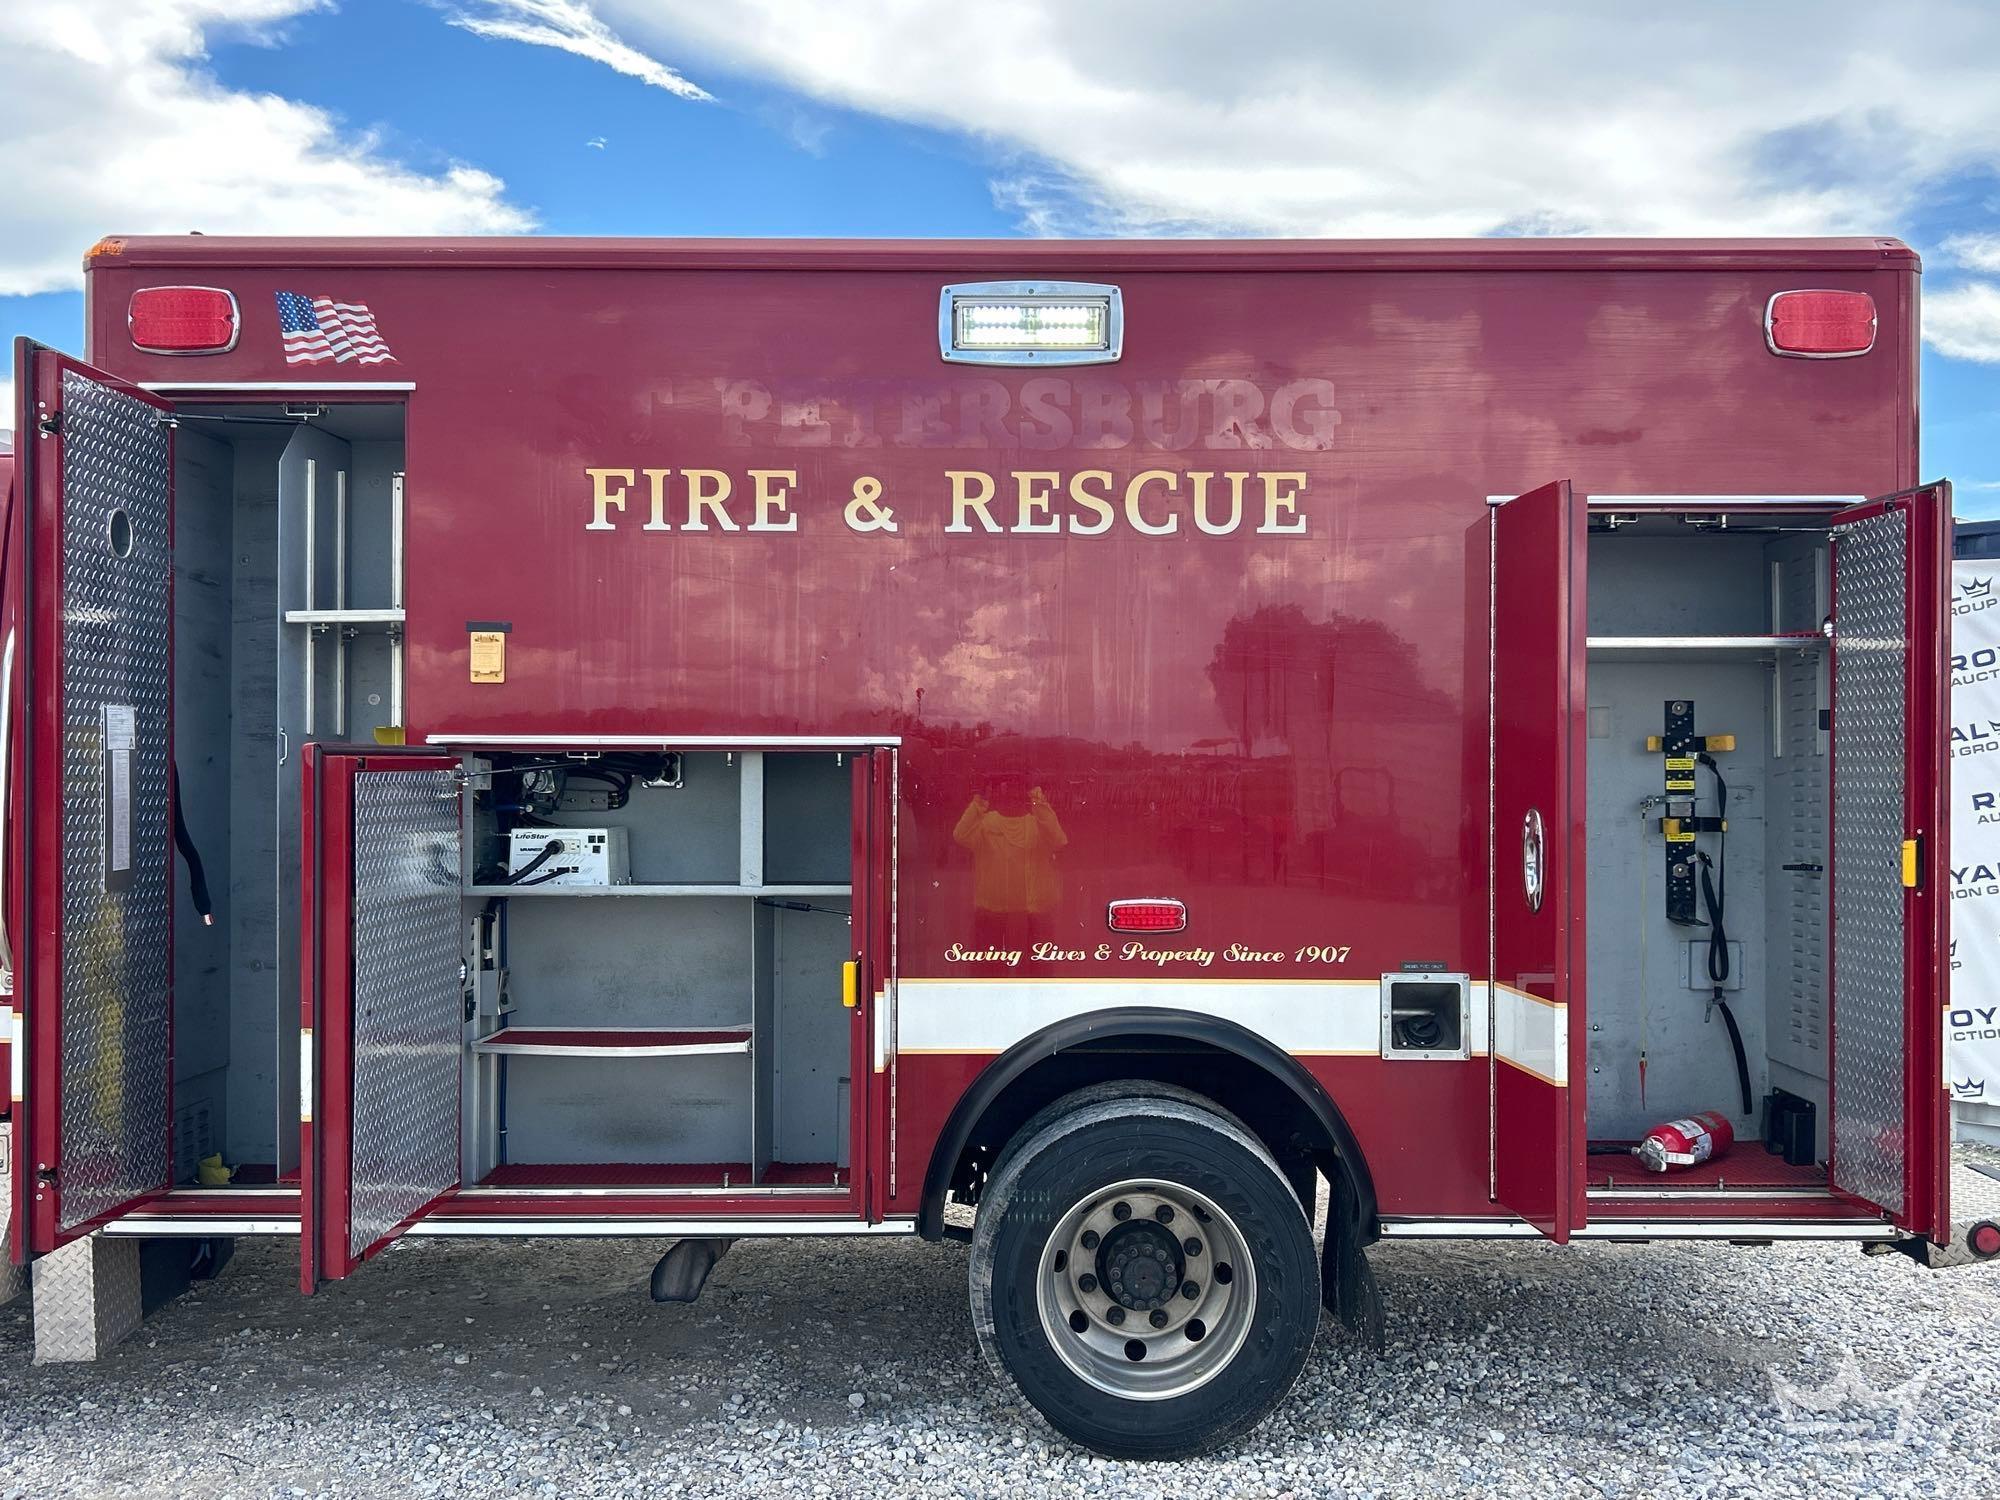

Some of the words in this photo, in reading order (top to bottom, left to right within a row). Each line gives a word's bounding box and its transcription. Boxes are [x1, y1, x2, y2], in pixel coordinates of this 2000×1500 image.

[585, 468, 798, 532] FIRE
[843, 475, 898, 533] &
[944, 469, 1308, 535] RESCUE
[1951, 645, 2000, 672] RO
[1951, 862, 2000, 885] YA
[944, 942, 1023, 967] Saving
[1030, 941, 1086, 961] Lives
[1094, 943, 1112, 961] &
[1118, 941, 1215, 967] Property
[1222, 942, 1286, 963] Since
[1294, 945, 1352, 963] 1907
